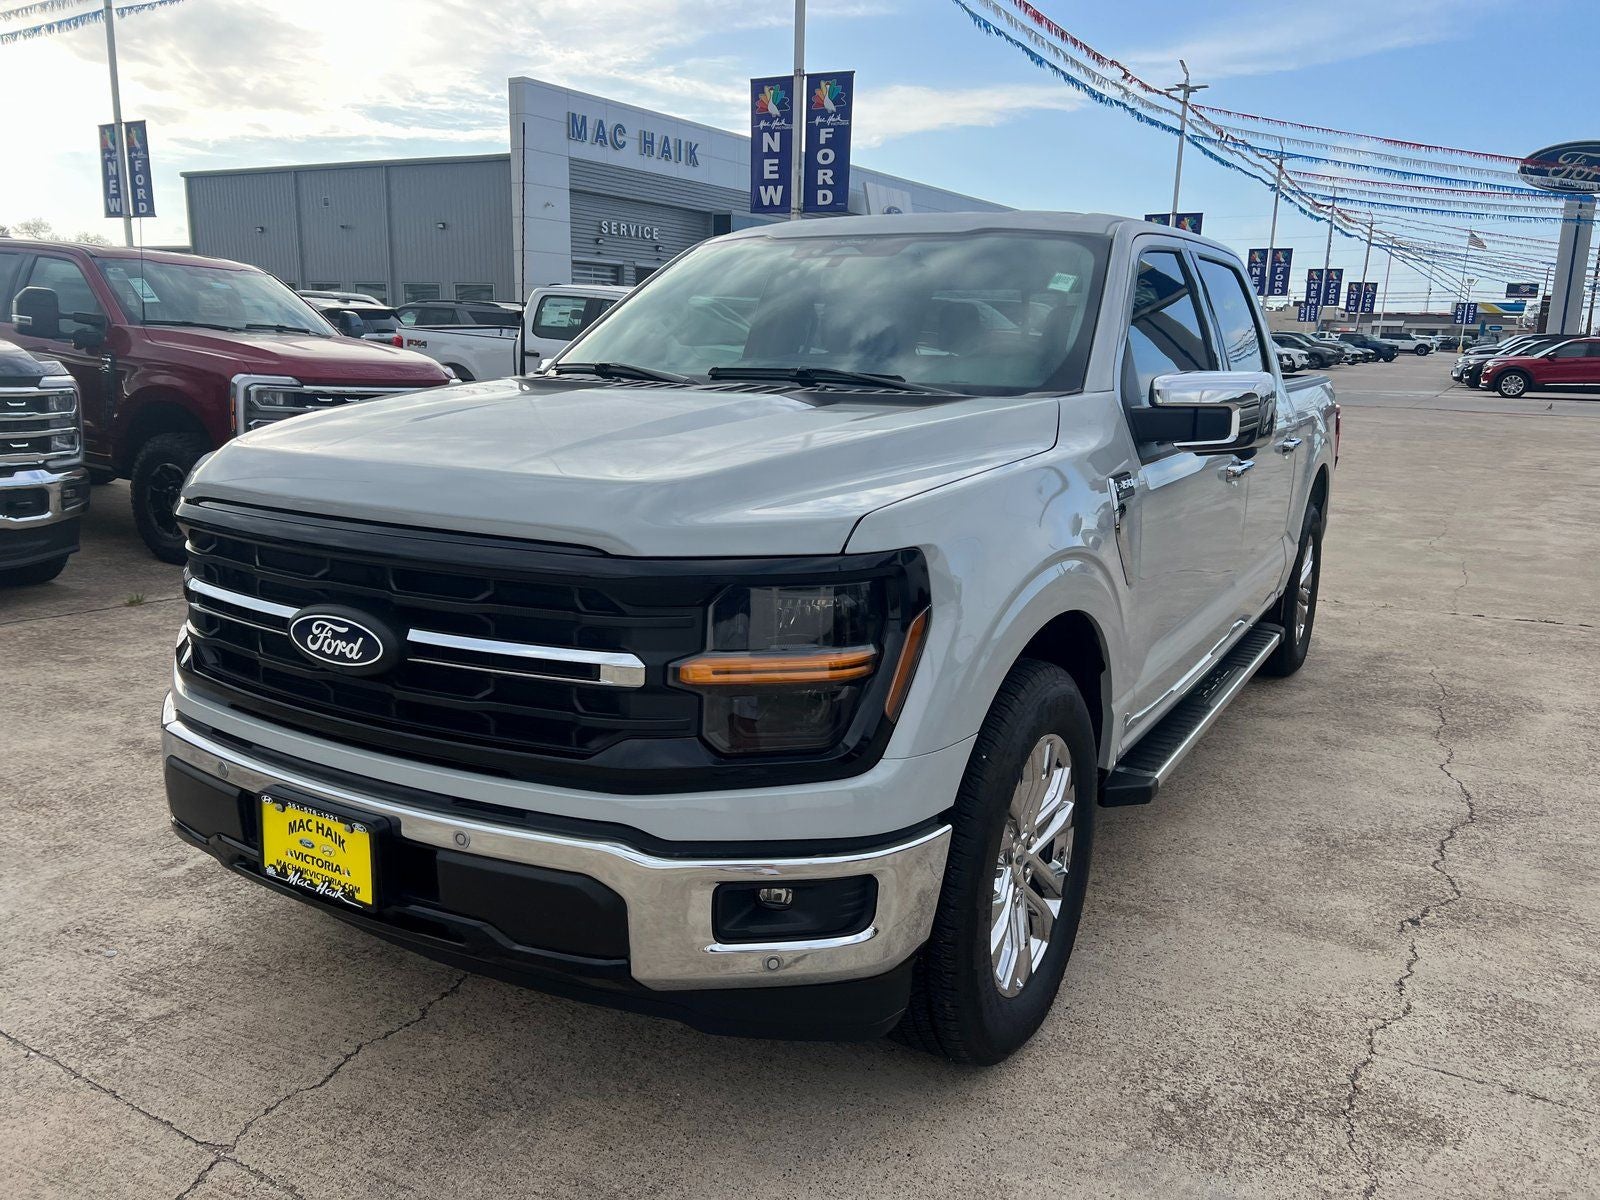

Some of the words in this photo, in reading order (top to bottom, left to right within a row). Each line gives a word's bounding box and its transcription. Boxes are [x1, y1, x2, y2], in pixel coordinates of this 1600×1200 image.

[568, 111, 627, 151] MAC
[639, 129, 700, 168] HAIK
[759, 132, 784, 206] NEW
[816, 128, 835, 206] FORD
[107, 161, 121, 213] NEW
[134, 160, 148, 214] FORD
[601, 220, 659, 240] SERVICE
[1251, 267, 1261, 293] NE
[1273, 267, 1285, 295] FORD
[1308, 283, 1318, 305] NEW
[1327, 283, 1337, 305] FORD
[1348, 294, 1357, 312] NEW
[1364, 294, 1373, 312] FORD
[406, 338, 428, 349] FX4
[306, 620, 364, 660] Ford
[288, 819, 313, 836] MAC
[316, 821, 347, 854] HAIK
[293, 850, 342, 875] VICTORIA
[286, 870, 316, 889] Mac
[315, 881, 346, 899] Haik
